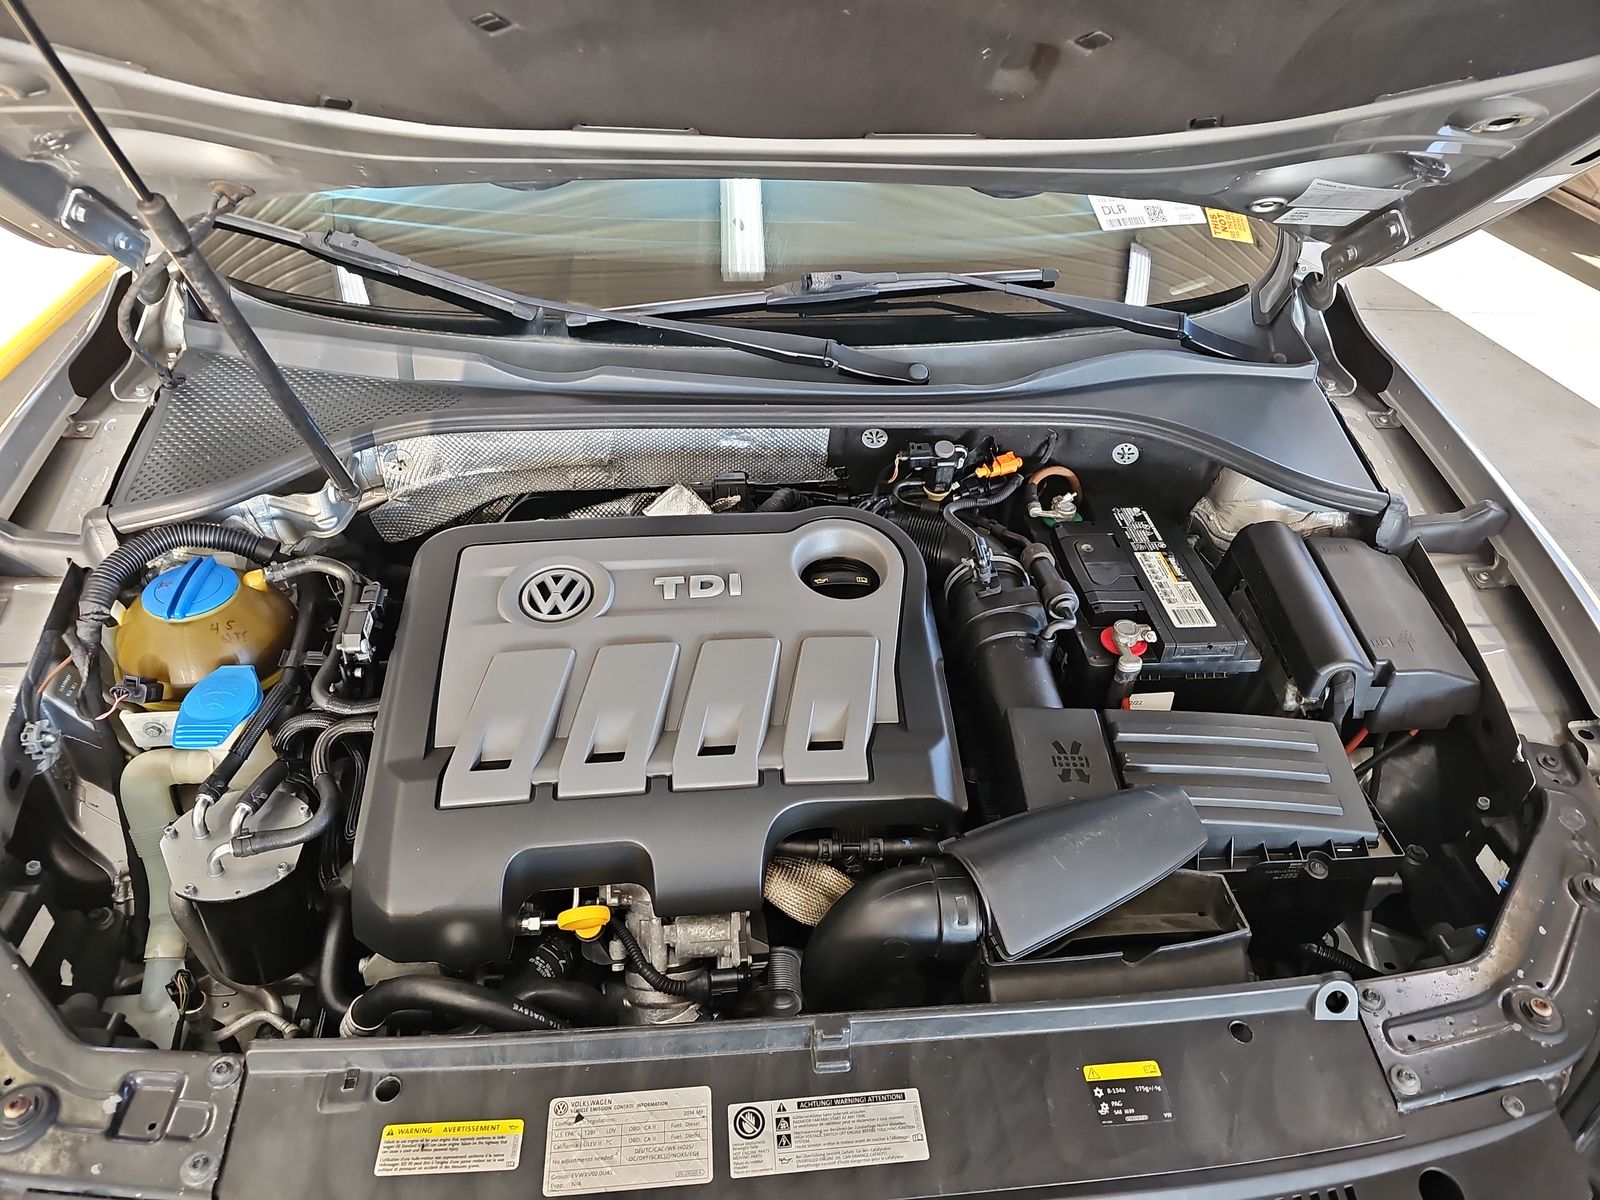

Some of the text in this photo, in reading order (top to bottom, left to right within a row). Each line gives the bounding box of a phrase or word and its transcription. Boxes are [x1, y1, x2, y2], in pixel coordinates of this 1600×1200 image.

[1101, 205, 1127, 215] DLR
[1210, 214, 1221, 235] THIS
[1217, 213, 1228, 233] NOT
[653, 573, 743, 600] TDI
[570, 1099, 612, 1107] VOLKSWAGEN
[800, 1093, 903, 1108] ACHTUNG! WARNING! ATTENTION!
[442, 1124, 500, 1132] AVERTISSEMENT
